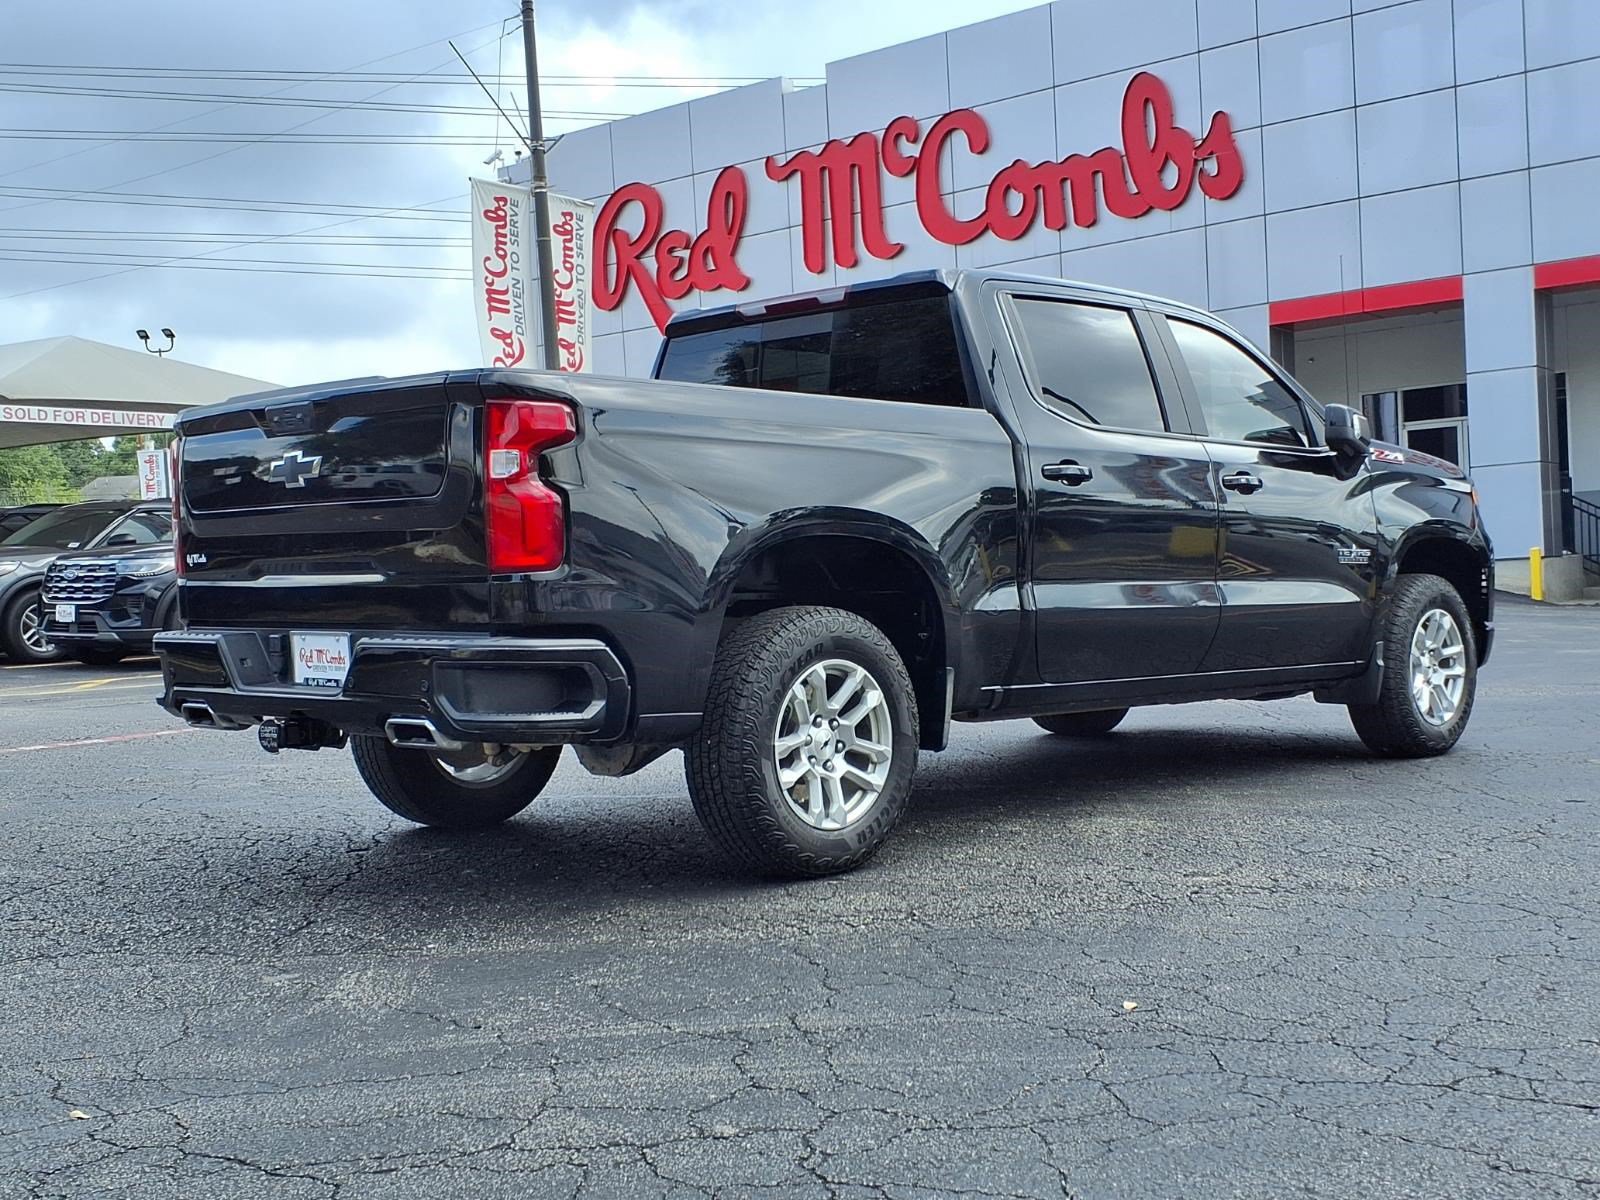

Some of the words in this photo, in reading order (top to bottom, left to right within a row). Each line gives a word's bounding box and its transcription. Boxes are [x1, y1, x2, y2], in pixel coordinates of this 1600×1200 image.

[509, 197, 520, 248] SERVE
[592, 166, 751, 336] Red
[765, 72, 1245, 274] McCombs
[483, 196, 511, 321] McCombs
[511, 251, 520, 272] TO
[575, 213, 584, 261] SERVE
[552, 211, 577, 331] McCombs
[576, 264, 585, 283] TO
[511, 278, 525, 337] DRIVEN
[575, 291, 586, 345] DRIVEN
[3, 406, 48, 421] SOLD
[53, 409, 87, 422] FOR
[91, 411, 165, 427] DELIVERY
[299, 647, 314, 669] Red
